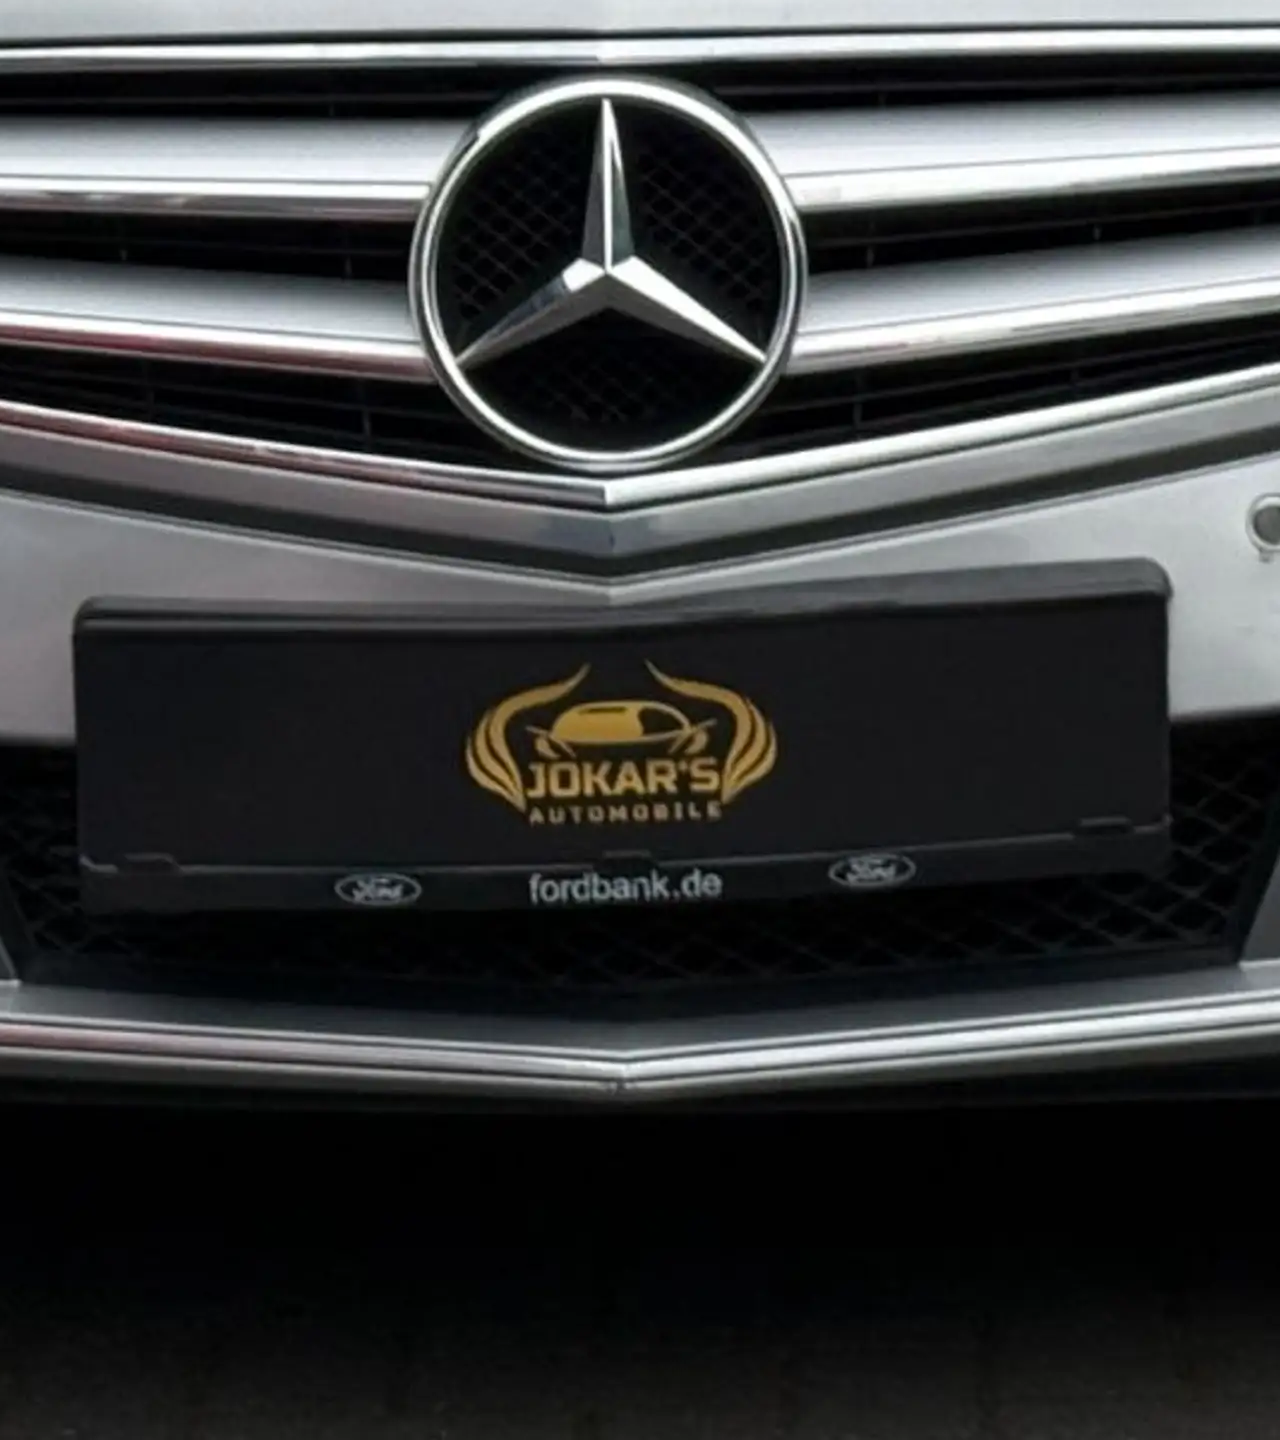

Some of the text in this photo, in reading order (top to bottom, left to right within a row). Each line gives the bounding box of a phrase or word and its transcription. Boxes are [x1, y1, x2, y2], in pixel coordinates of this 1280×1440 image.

[526, 757, 720, 798] JOKAR'S
[529, 801, 722, 825] AUTOMOBILE
[529, 868, 723, 904] fordbank.de
